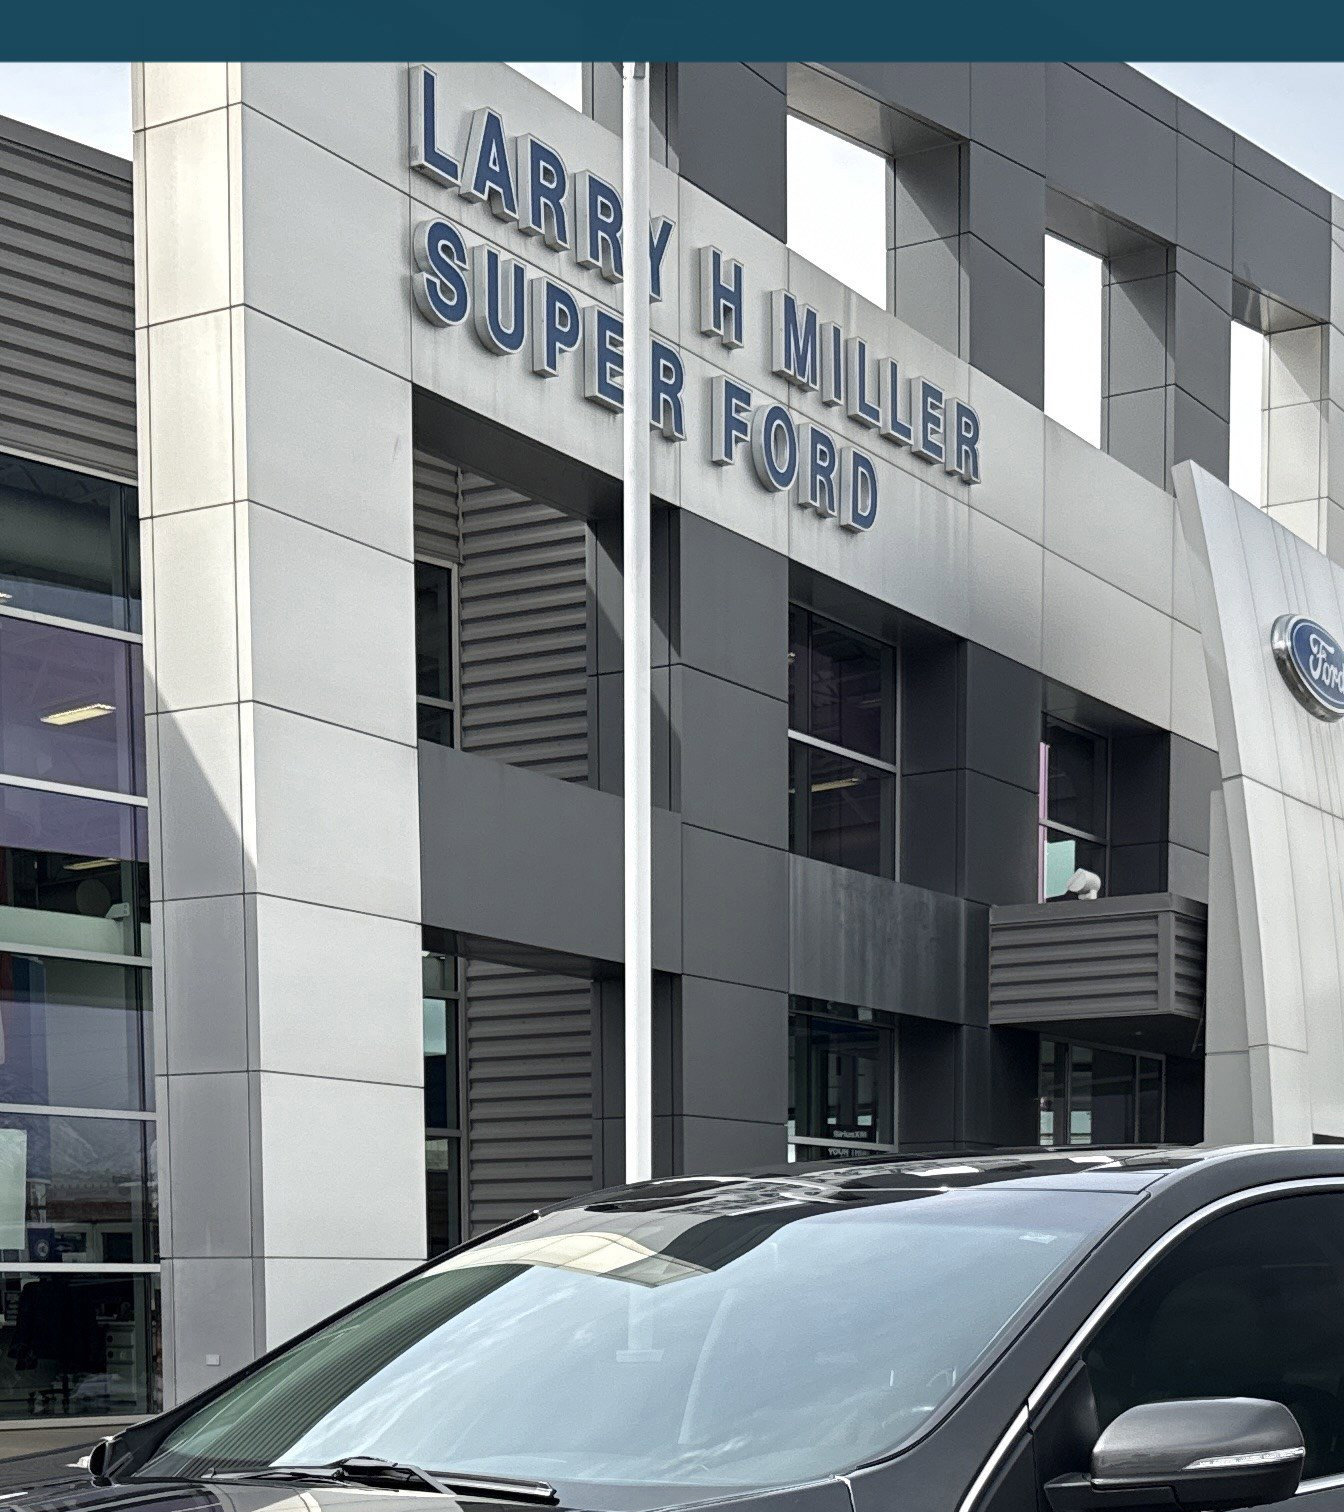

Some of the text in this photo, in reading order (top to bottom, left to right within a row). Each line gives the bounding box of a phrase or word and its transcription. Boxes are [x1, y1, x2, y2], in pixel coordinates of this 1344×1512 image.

[409, 64, 981, 485] LARRY H MILLER
[413, 216, 879, 533] SUPER FORD
